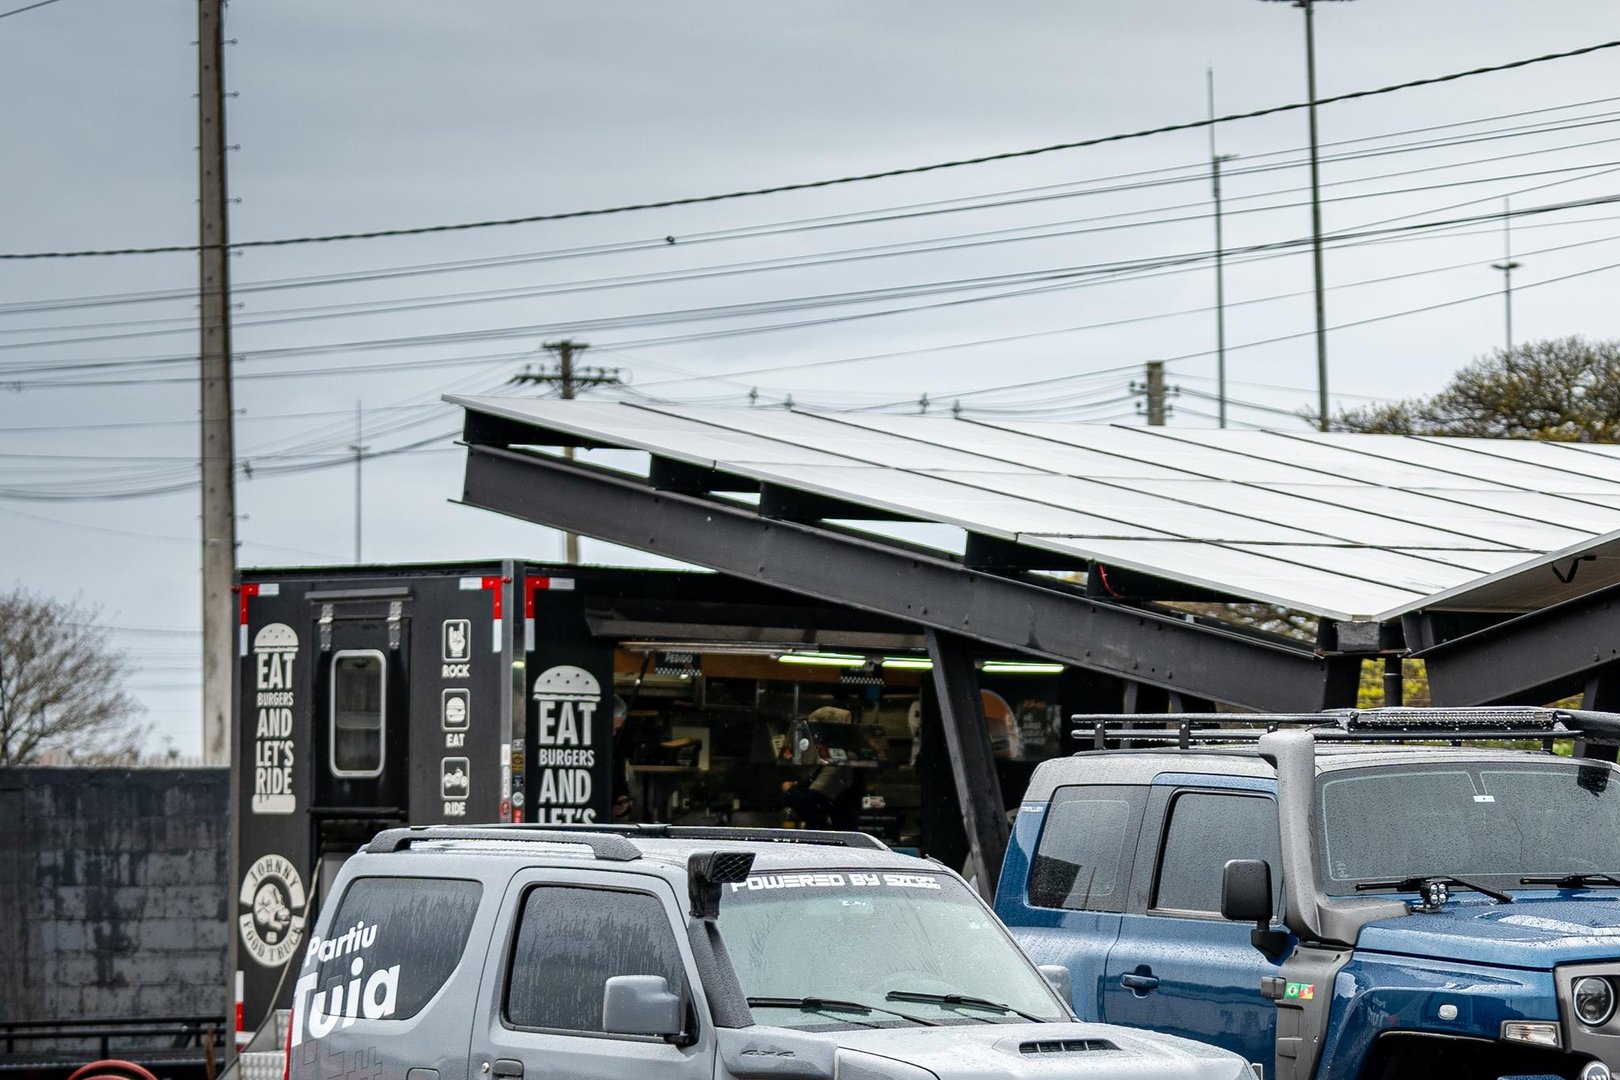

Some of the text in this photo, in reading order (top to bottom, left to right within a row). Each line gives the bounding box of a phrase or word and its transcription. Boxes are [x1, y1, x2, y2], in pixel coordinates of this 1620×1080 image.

[257, 653, 294, 690] EAT
[442, 664, 470, 678] ROCK
[257, 692, 294, 707] BURGERS
[256, 709, 292, 738] AND
[539, 701, 597, 746] EAT
[256, 742, 294, 768] LET'S
[446, 734, 464, 748] EAT
[539, 749, 595, 767] BURGERS
[255, 768, 292, 797] RIDE
[538, 769, 592, 802] AND
[443, 802, 466, 816] RIDE
[250, 858, 299, 887] JOHNNY
[731, 874, 845, 892] POWERED
[851, 873, 880, 886] BY
[243, 921, 266, 957] FOOD
[305, 921, 378, 968] Partiu
[290, 957, 401, 1048] Tuia
